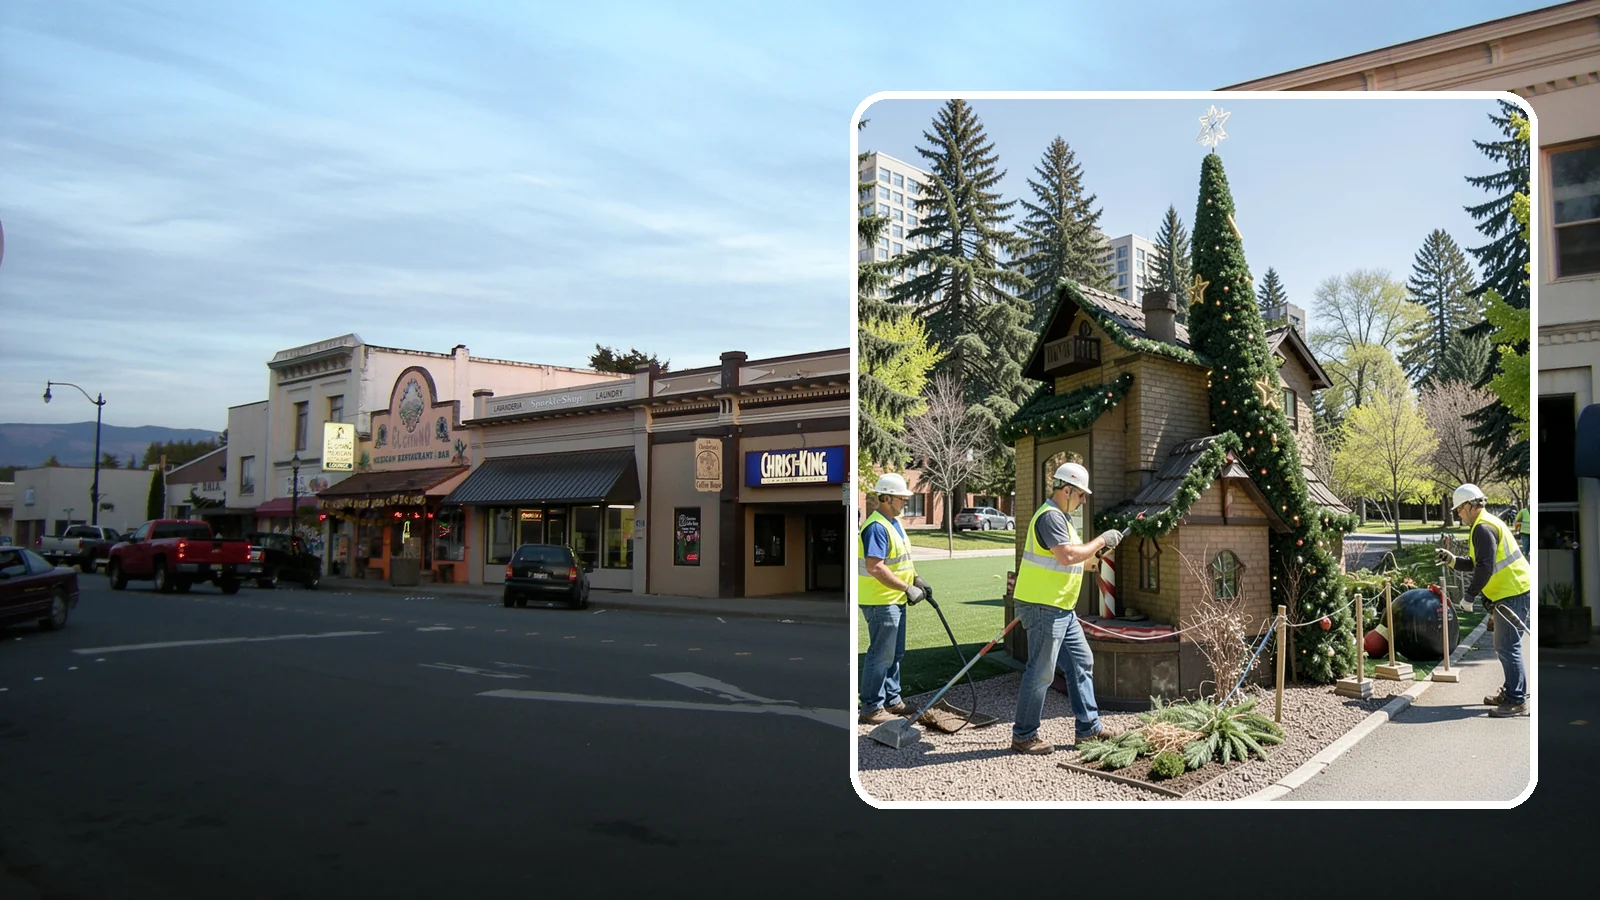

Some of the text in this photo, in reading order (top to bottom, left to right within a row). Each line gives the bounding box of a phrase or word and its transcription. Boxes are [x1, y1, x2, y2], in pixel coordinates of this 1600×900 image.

[595, 389, 624, 400] LAUNDRY
[493, 402, 522, 412] LAVANDERIA
[397, 451, 433, 462] RESTAURANT
[437, 450, 450, 458] BAR
[761, 450, 827, 478] CHRIST KING
